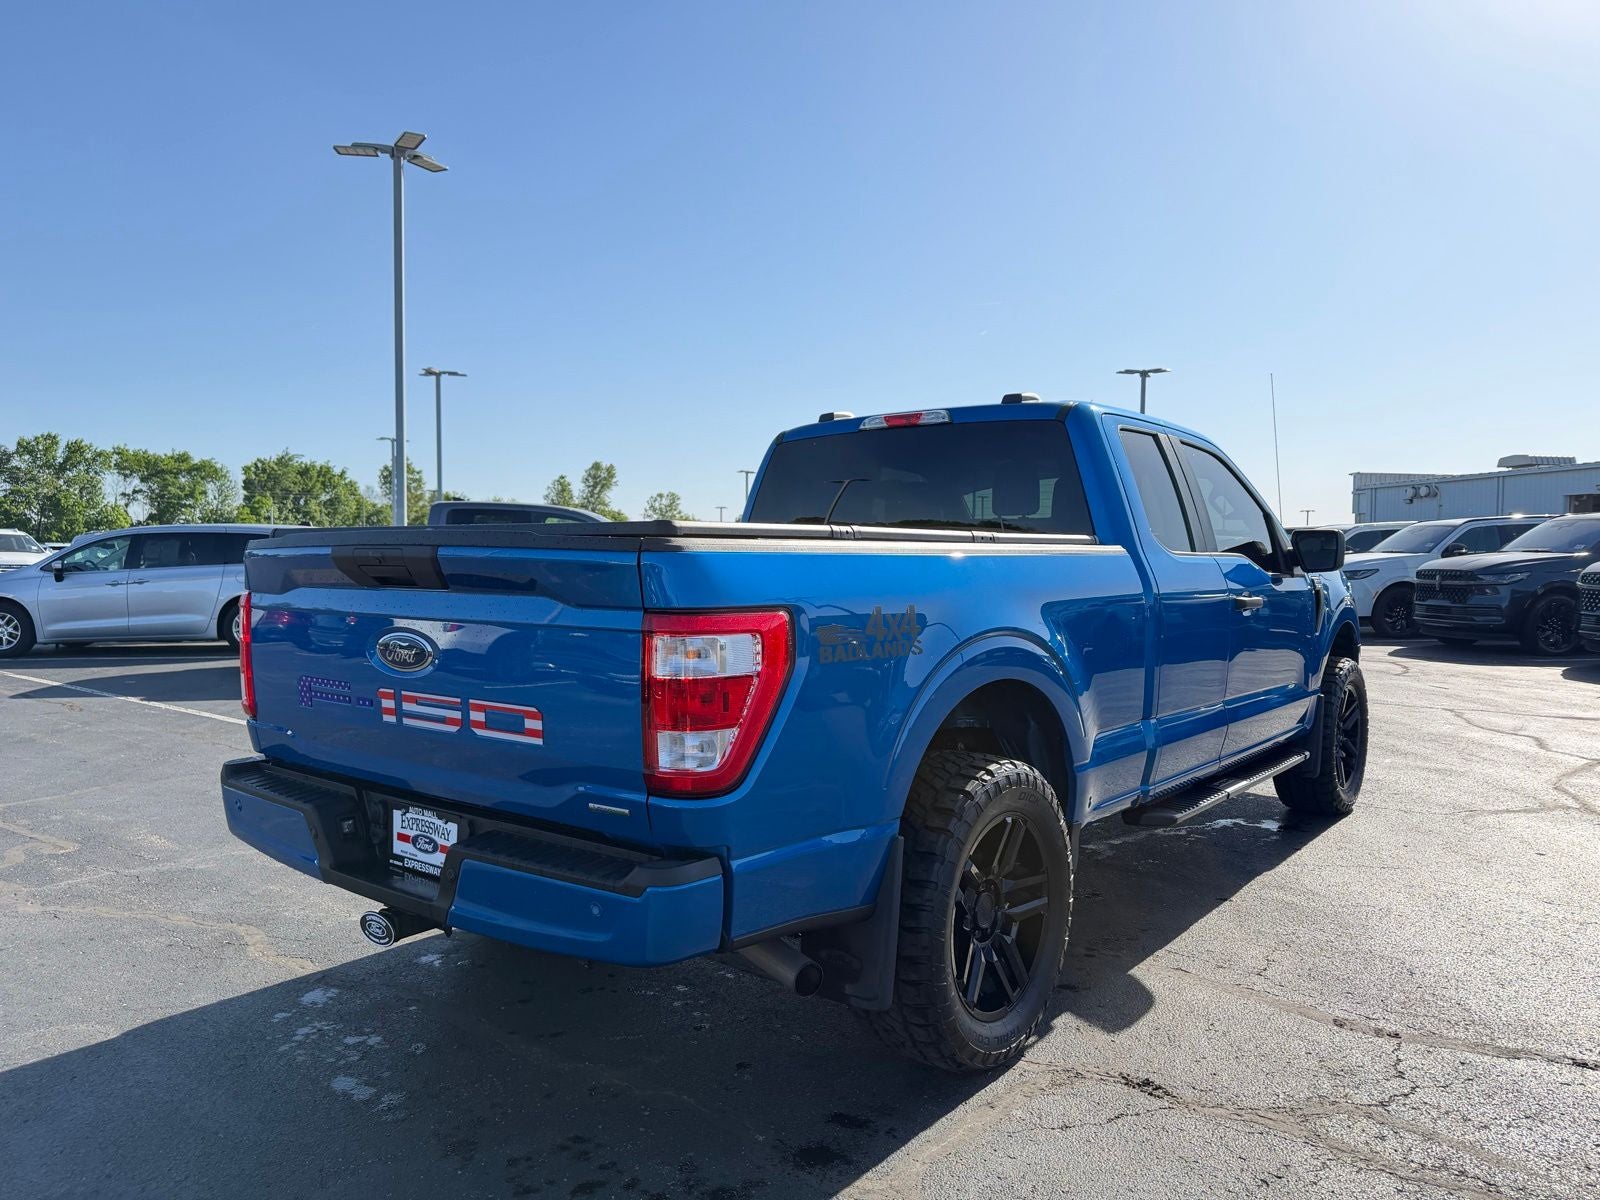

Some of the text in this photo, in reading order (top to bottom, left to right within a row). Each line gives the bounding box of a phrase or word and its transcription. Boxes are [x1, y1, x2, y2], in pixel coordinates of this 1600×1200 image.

[385, 639, 417, 664] Ford
[819, 639, 923, 664] BADLANDS
[298, 675, 544, 745] F-150
[400, 814, 452, 842] EXPRESSWAY
[416, 836, 435, 852] Ford
[404, 858, 442, 876] EXPRESSWAY
